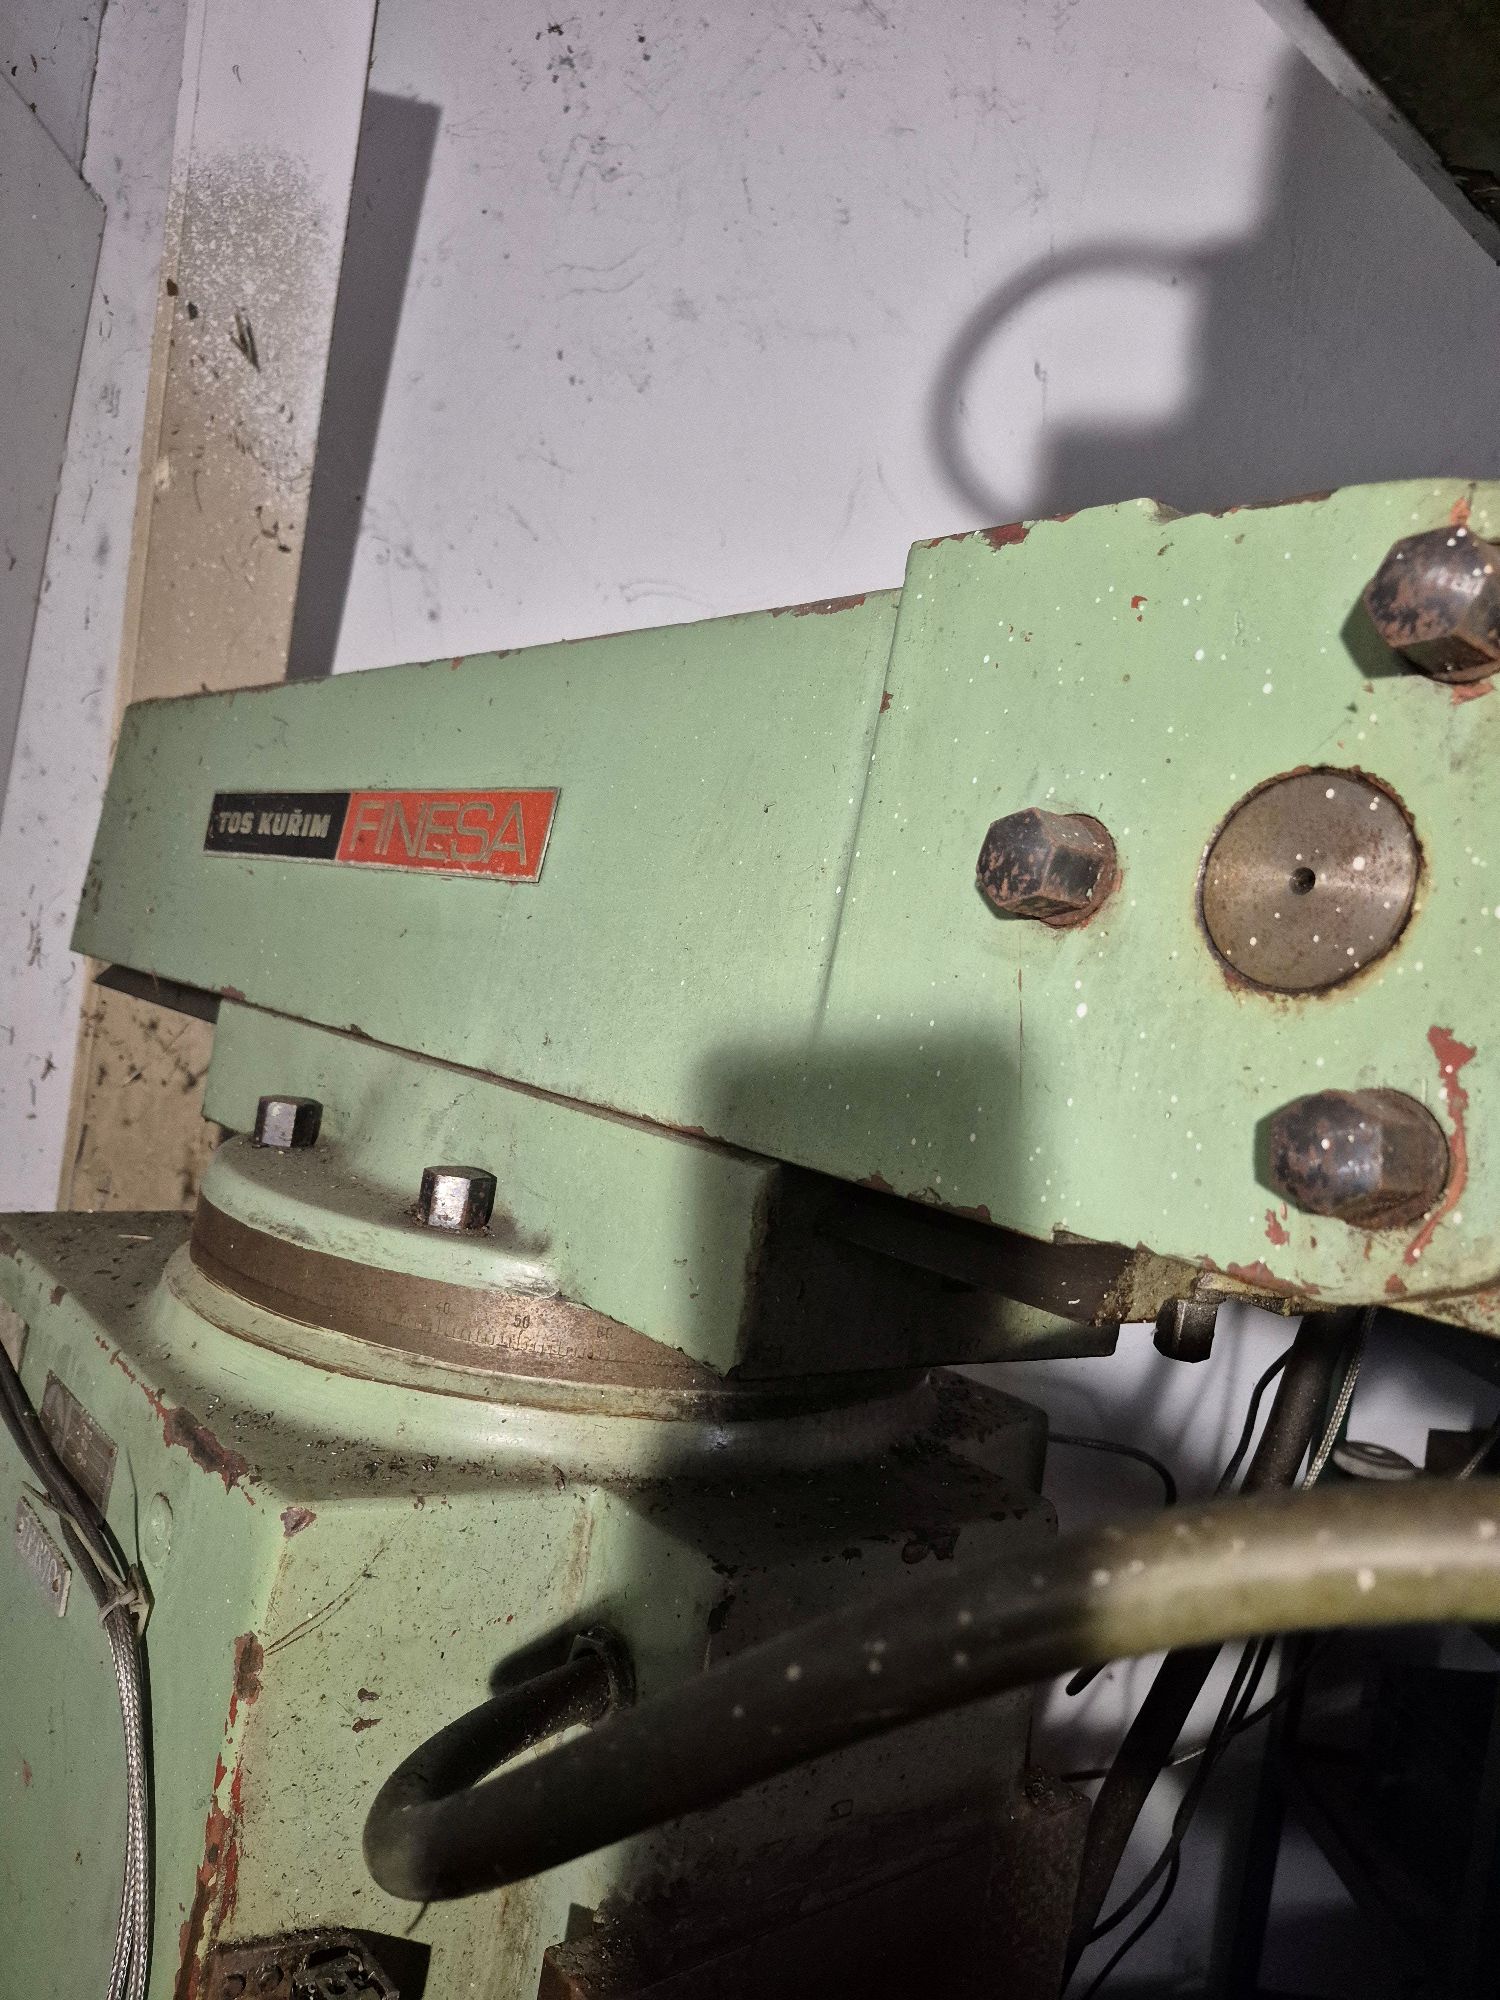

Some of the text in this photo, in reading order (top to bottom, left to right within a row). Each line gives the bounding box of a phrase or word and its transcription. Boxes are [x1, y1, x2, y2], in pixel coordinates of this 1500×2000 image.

[219, 809, 331, 838] TOS KUŘIM
[350, 800, 528, 866] FINESA
[513, 1314, 530, 1329] 50
